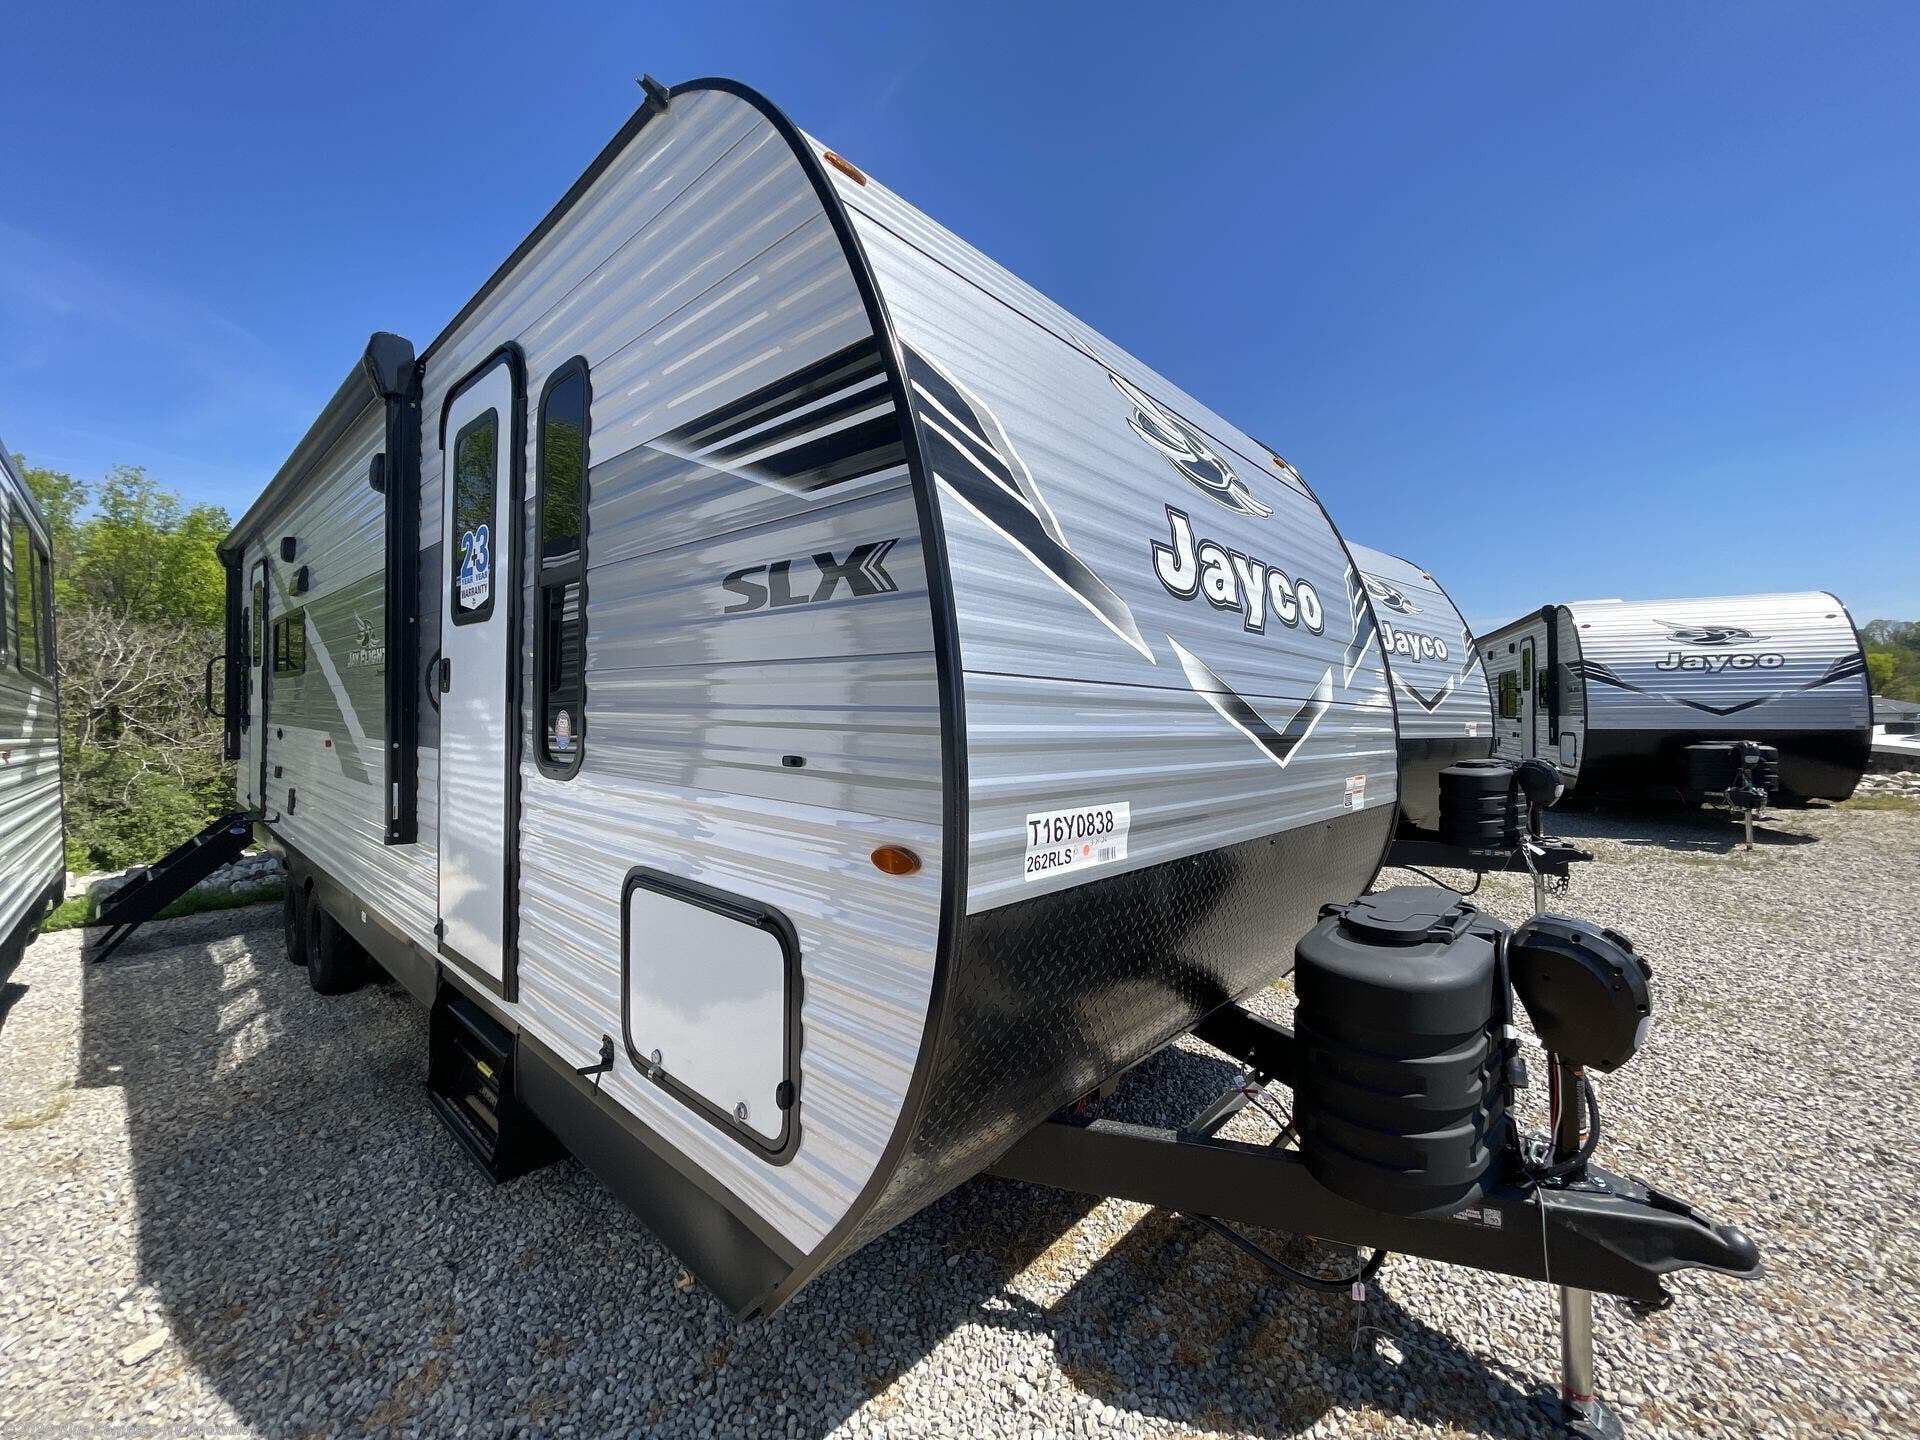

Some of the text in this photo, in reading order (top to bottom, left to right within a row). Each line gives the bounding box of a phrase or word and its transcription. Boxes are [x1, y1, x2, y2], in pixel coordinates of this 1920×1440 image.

[722, 537, 900, 614] SLX
[1150, 503, 1324, 636] Jayco
[461, 583, 488, 599] WARRANTY
[1381, 620, 1449, 663] Jayco
[1655, 651, 1785, 674] Jayco
[1029, 810, 1114, 846] T16Y0838
[1026, 848, 1072, 873] 262RLS
